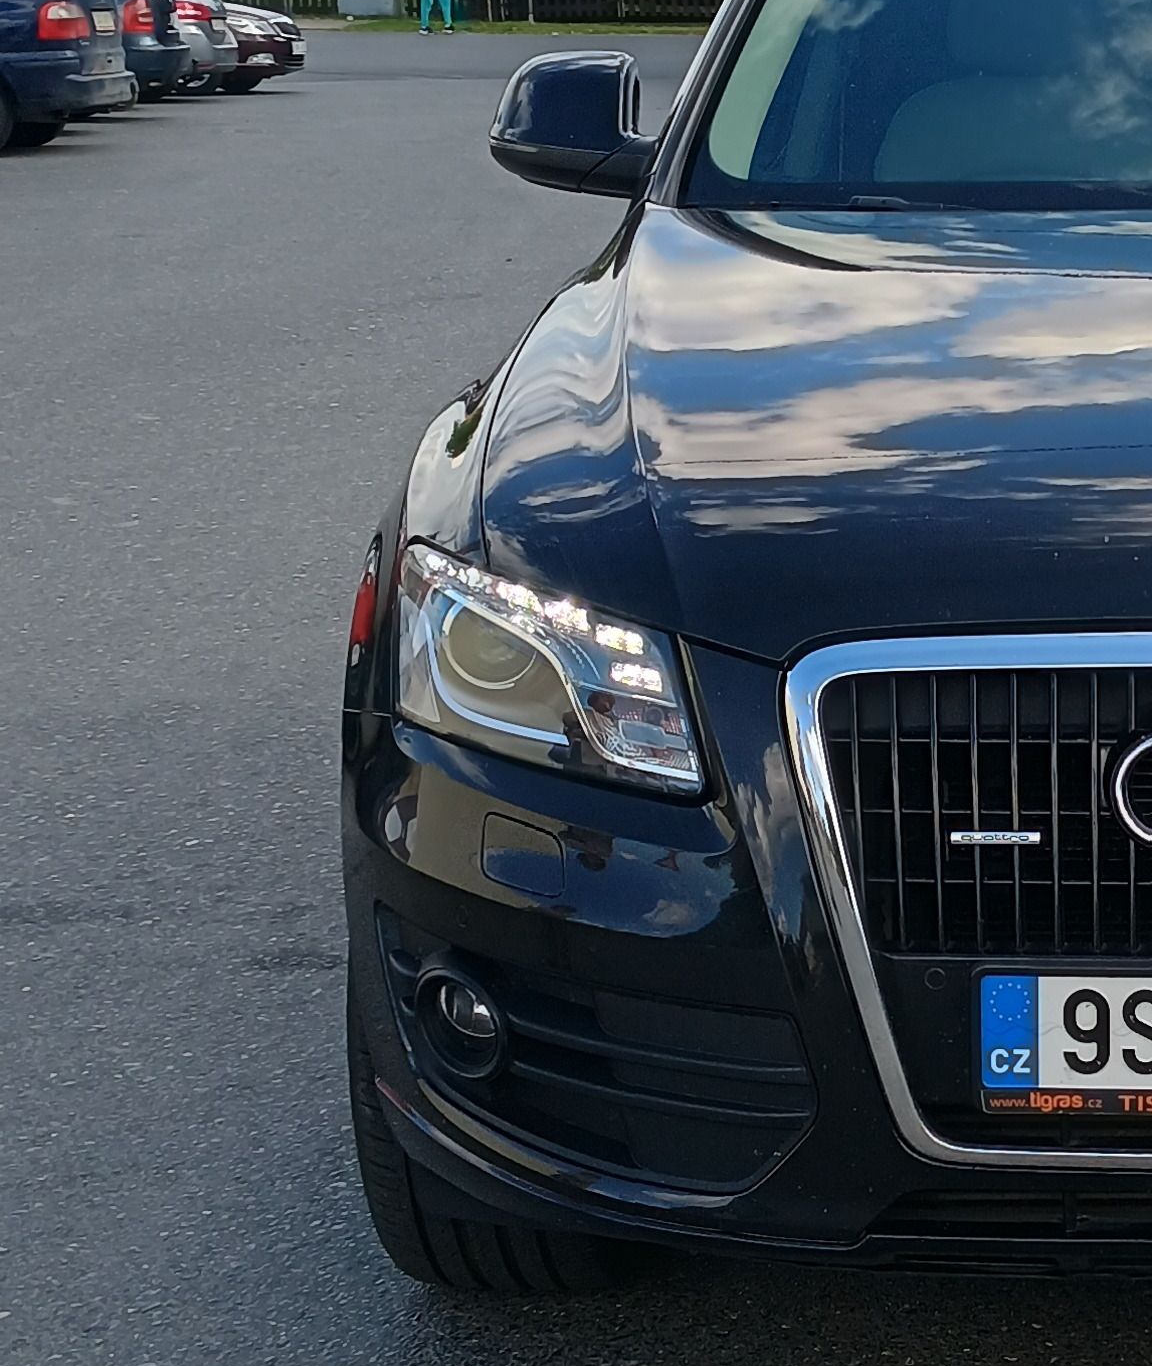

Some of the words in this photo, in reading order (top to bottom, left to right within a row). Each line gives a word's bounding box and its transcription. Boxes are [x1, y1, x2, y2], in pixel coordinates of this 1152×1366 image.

[960, 833, 1030, 843] quattro
[990, 1048, 1032, 1074] CZ
[989, 1091, 1103, 1112] www.tigras.cz
